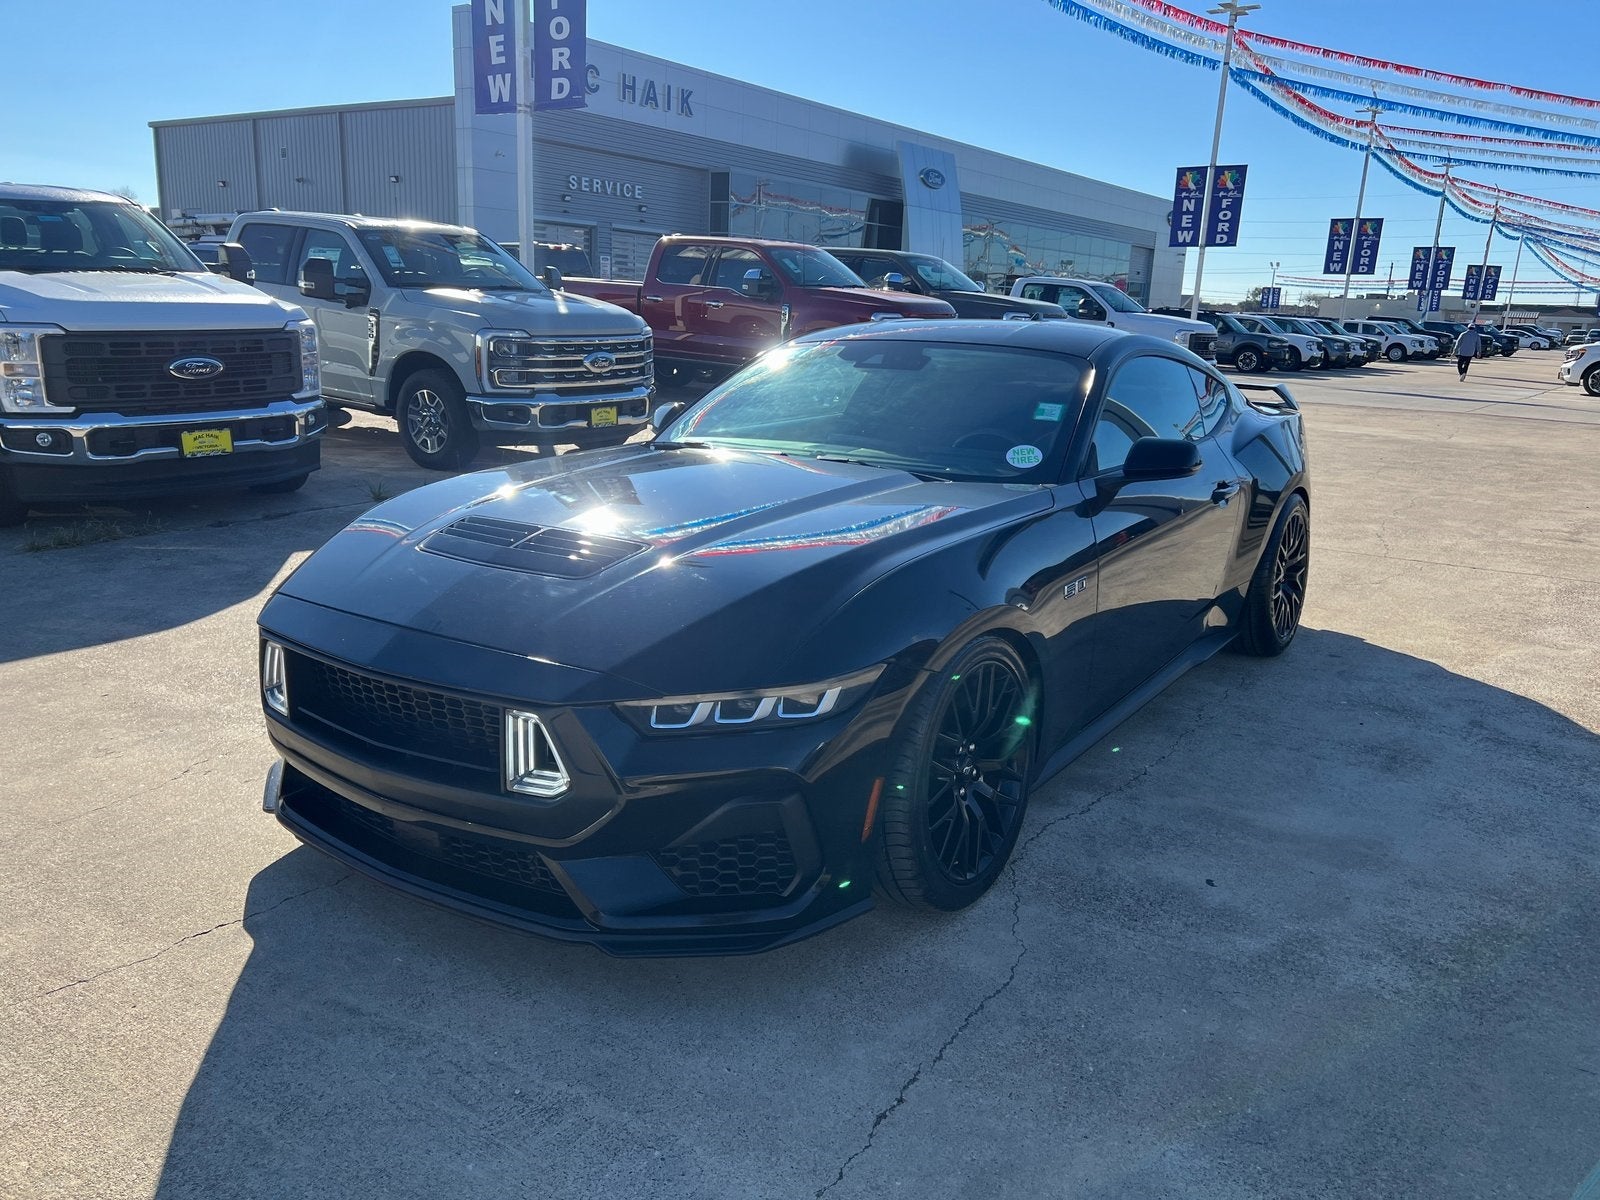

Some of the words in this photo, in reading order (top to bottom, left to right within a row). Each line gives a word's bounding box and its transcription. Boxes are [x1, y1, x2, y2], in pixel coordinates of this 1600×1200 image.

[485, 0, 511, 103] NEW
[620, 73, 694, 117] HAIK
[569, 175, 643, 199] SERVICE
[1177, 199, 1195, 243] NEW
[1215, 198, 1233, 244] FORD
[1329, 241, 1344, 272] NEW
[1358, 241, 1372, 273] FORD
[1412, 264, 1424, 288] NEW
[1435, 264, 1446, 289] FORD
[1465, 279, 1476, 298] NEW
[1484, 279, 1494, 299] FORD
[1010, 455, 1040, 464] TIRES
[1012, 448, 1035, 456] NEW
